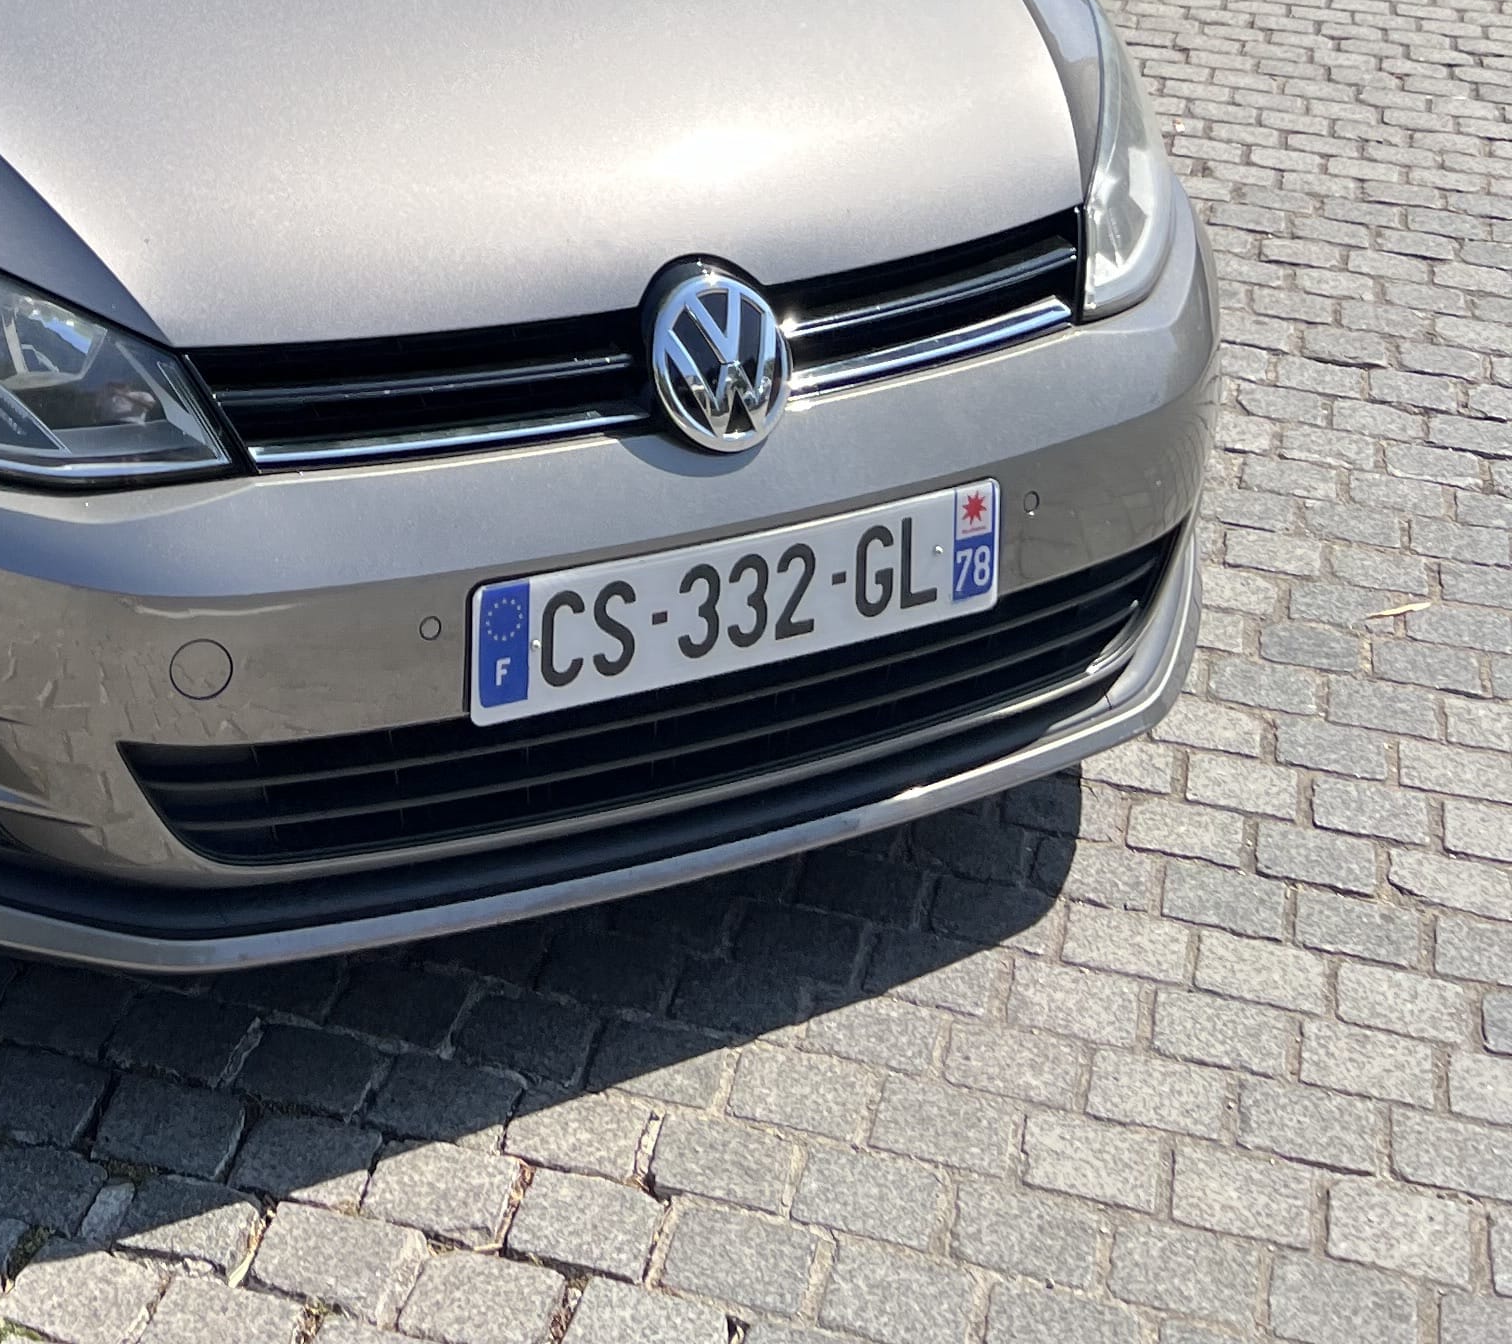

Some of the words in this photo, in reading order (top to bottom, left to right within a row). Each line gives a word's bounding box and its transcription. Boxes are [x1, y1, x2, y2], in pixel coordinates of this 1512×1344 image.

[495, 656, 511, 687] F
[540, 516, 938, 688] CS-332-GL
[955, 544, 991, 593] 78
